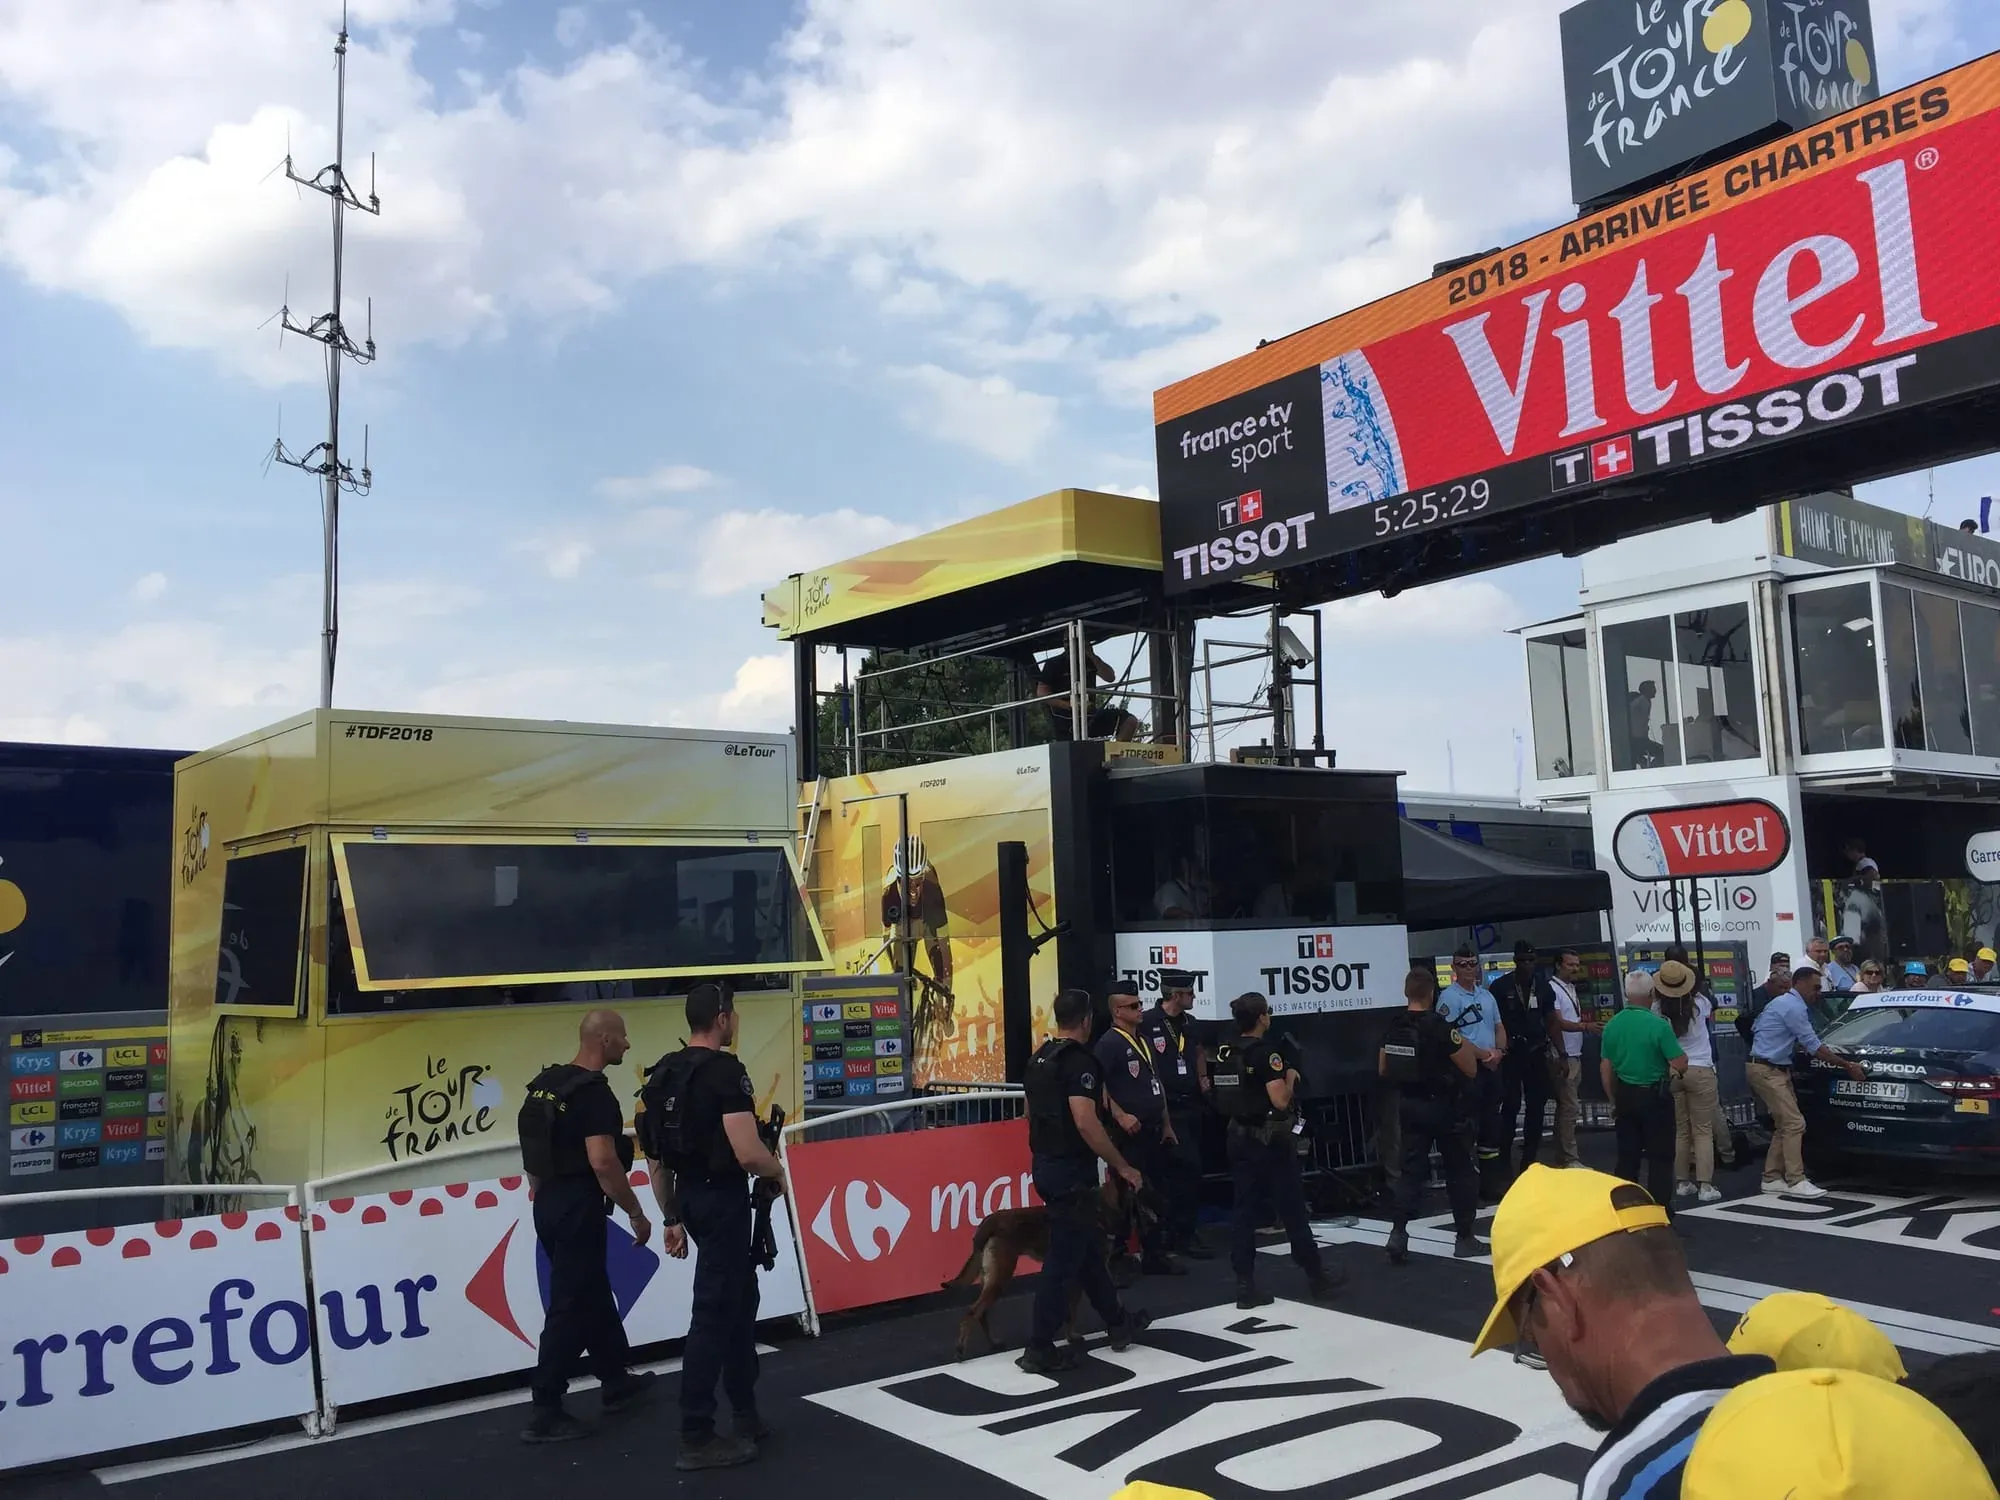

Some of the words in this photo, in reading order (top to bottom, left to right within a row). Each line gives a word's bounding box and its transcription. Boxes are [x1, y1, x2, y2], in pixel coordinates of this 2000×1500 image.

[1588, 91, 1604, 112] de
[1448, 251, 1529, 305] 2018
[1559, 178, 1711, 263] ARRIVÉE
[1724, 86, 1950, 198] CHARTRES
[1638, 353, 1917, 466] TISSOT
[1231, 429, 1293, 472] sport
[1374, 478, 1490, 537] 5:25:29
[1800, 505, 1832, 551] HOME
[1834, 514, 1848, 557] OF
[1850, 520, 1895, 564] CYCLING
[1173, 511, 1315, 580] TISSOT
[345, 725, 433, 742] #TDF2018
[724, 744, 776, 759] @LeTour
[1672, 817, 1768, 860] Vittel
[1636, 918, 1760, 933] www.idelio.com
[1122, 969, 1209, 993] TIST
[1260, 962, 1370, 996] TISSOT
[1291, 1000, 1328, 1011] WATCHES
[1330, 998, 1353, 1008] SINCE
[1880, 992, 1942, 1003] Carrefour
[874, 1004, 897, 1014] Vittel
[115, 1050, 140, 1058] LCL
[16, 1056, 51, 1071] Krys
[819, 1064, 840, 1077] Krys
[847, 1063, 871, 1073] Vittel
[1872, 1061, 1928, 1075] ŠKODA
[15, 1082, 51, 1094] Vittel
[849, 1083, 871, 1093] Krys
[21, 1106, 48, 1116] LCL
[1829, 1097, 1861, 1109] Relations
[1863, 1099, 1906, 1112] Extérieures
[385, 1106, 400, 1119] de
[64, 1127, 96, 1142] Krys
[107, 1123, 139, 1136] Vittel
[1847, 1121, 1885, 1134] @letour
[106, 1148, 137, 1161] Krys
[3, 1274, 437, 1410] rrefour
